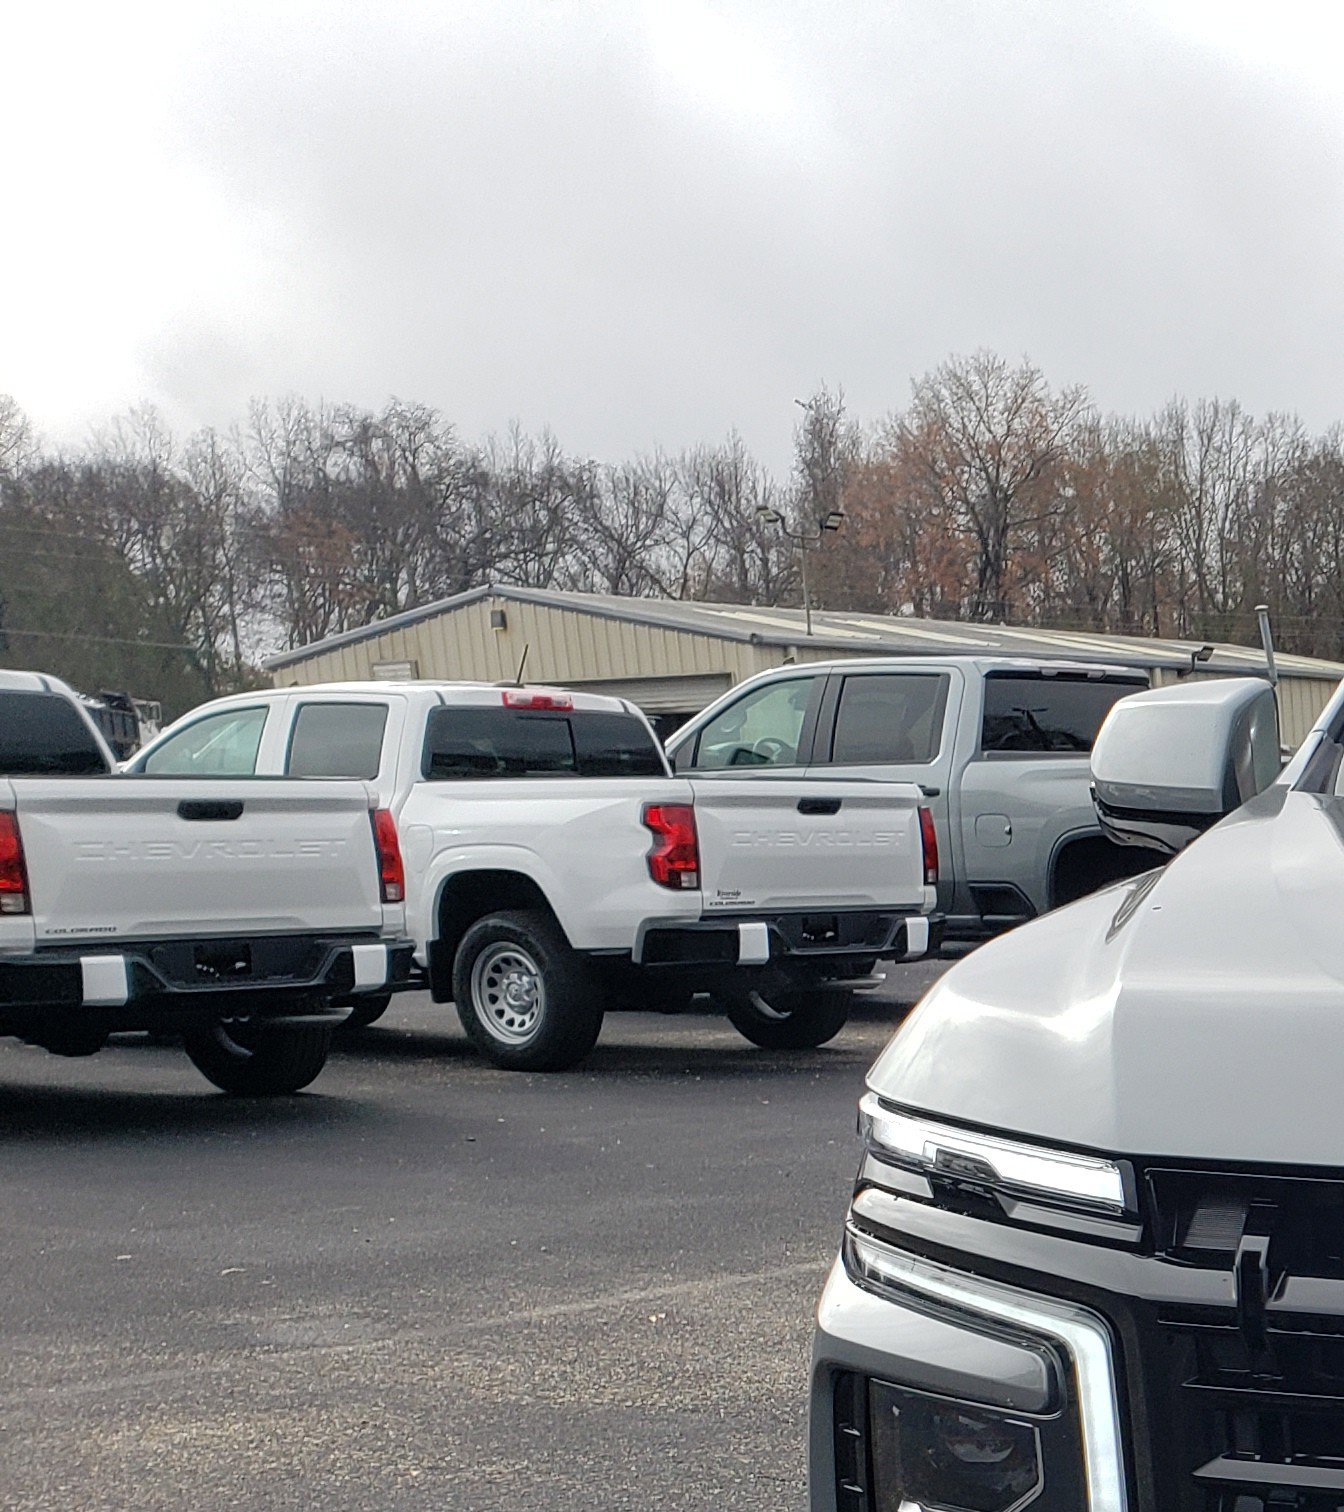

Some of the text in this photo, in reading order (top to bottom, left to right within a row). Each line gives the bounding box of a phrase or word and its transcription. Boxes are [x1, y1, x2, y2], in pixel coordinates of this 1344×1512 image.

[731, 830, 906, 847] CHEVROLET
[73, 838, 346, 861] CHEVROLET
[45, 926, 117, 934] COLORADO
